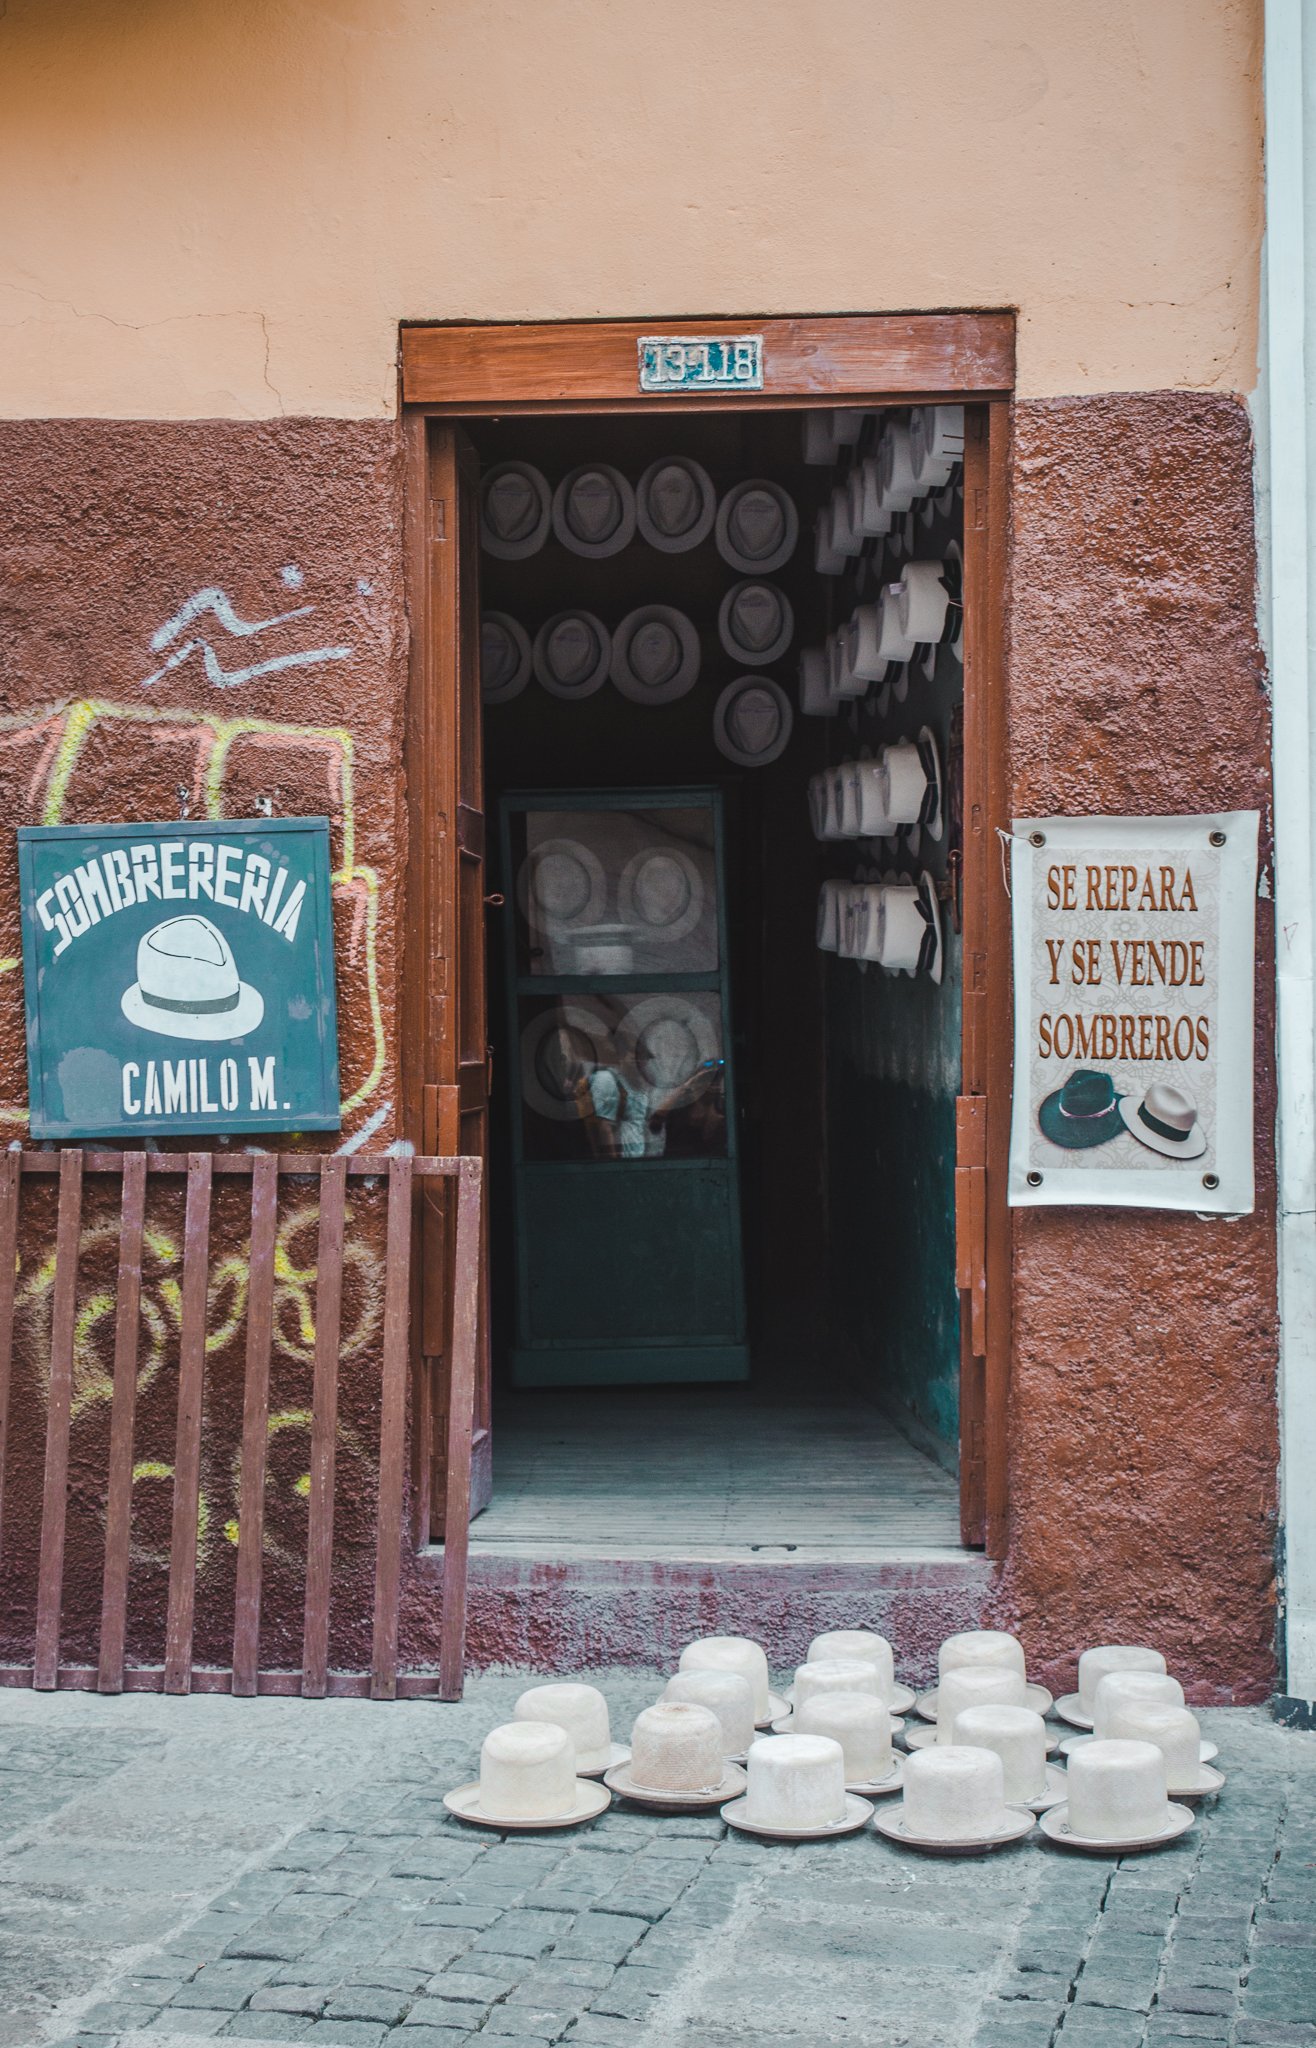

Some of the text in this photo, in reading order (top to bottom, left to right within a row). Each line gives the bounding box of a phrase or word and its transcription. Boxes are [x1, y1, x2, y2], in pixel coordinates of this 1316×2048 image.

[35, 841, 307, 957] SOMBRERERIA
[1046, 864, 1198, 912] SE REPARA
[1045, 939, 1205, 986] Y SE VENDE
[1038, 1013, 1210, 1061] SOMBREROS
[122, 1056, 291, 1115] CAMILO M.
